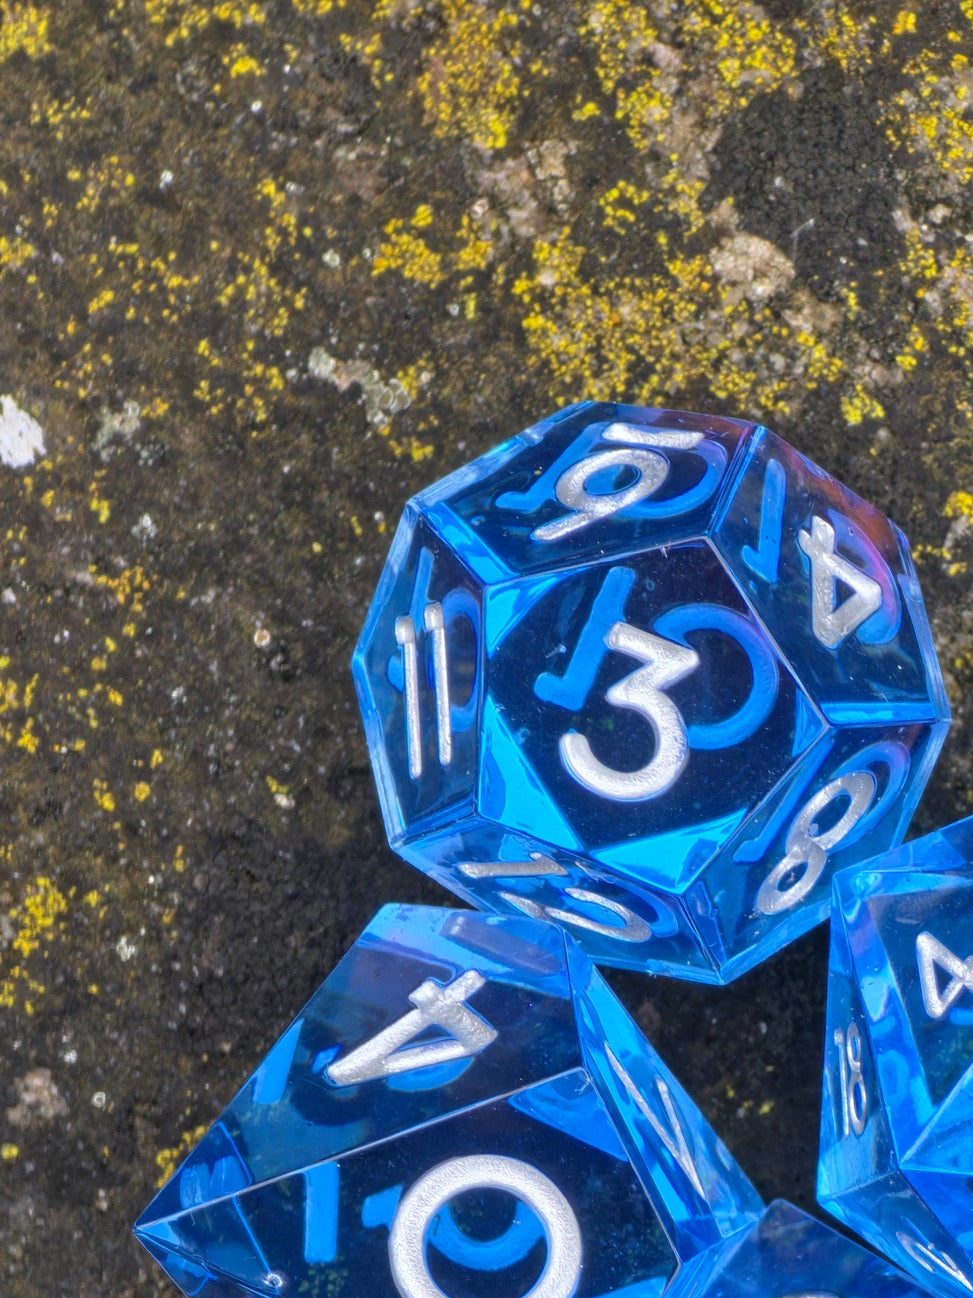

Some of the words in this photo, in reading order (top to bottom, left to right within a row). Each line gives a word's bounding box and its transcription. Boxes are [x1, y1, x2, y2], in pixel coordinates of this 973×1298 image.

[799, 514, 884, 650] 4
[394, 601, 454, 781] 11
[558, 620, 700, 802] 3
[755, 770, 878, 917] 8
[324, 969, 499, 1087] 4
[833, 1020, 868, 1138] 18
